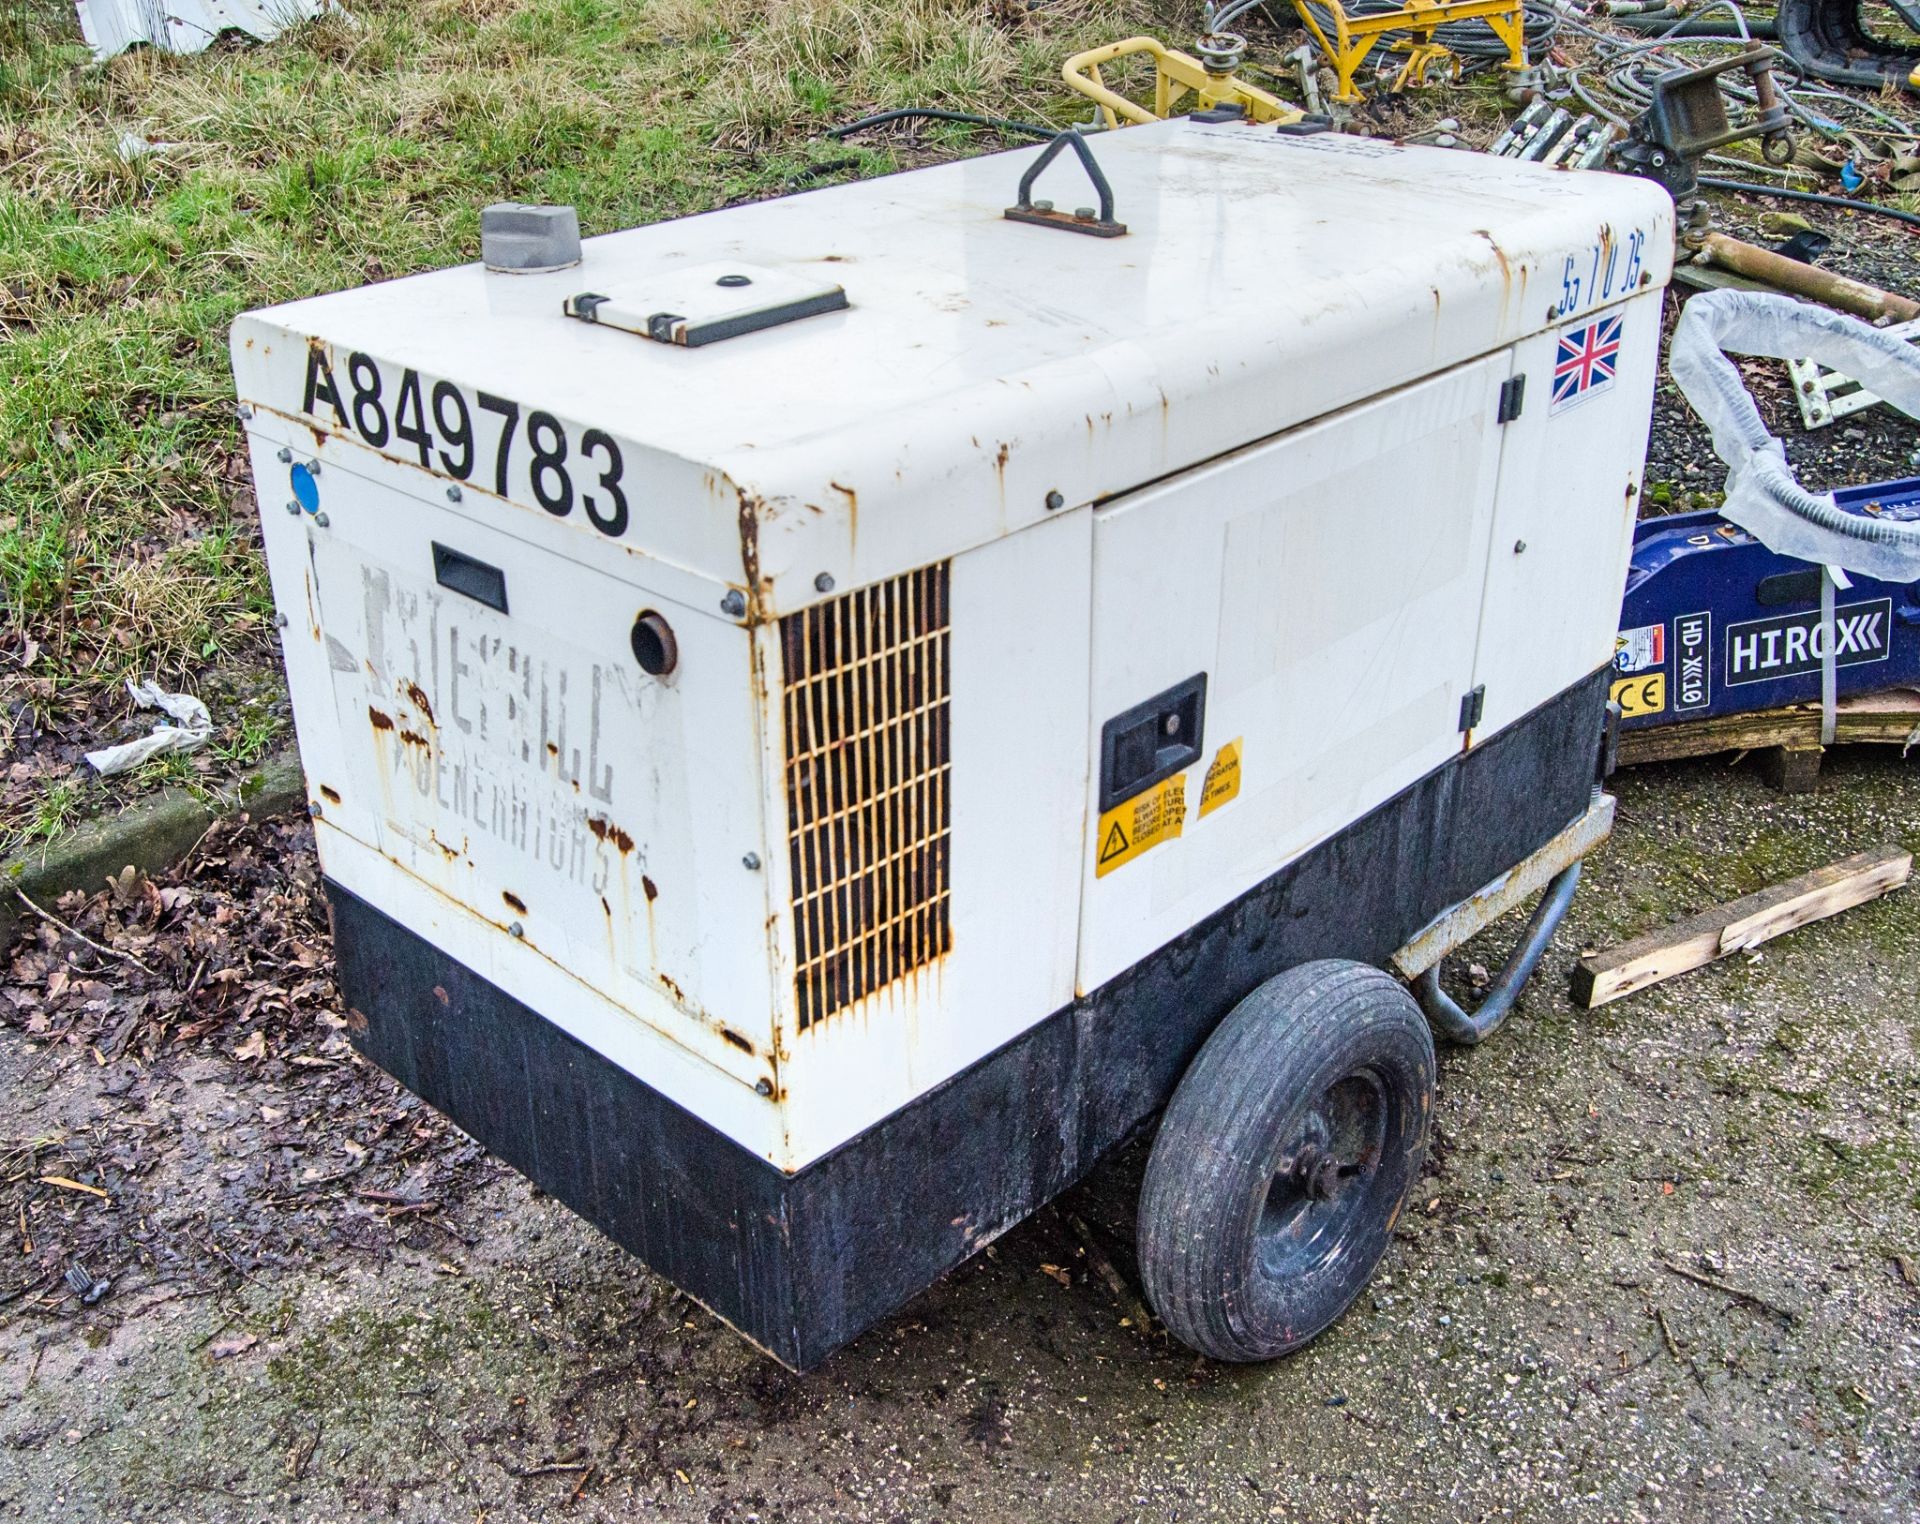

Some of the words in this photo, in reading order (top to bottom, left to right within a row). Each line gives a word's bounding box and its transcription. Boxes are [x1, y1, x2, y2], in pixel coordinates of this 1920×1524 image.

[303, 346, 629, 538] A849783
[1733, 615, 1861, 673] HIROX
[1617, 679, 1659, 711] CE
